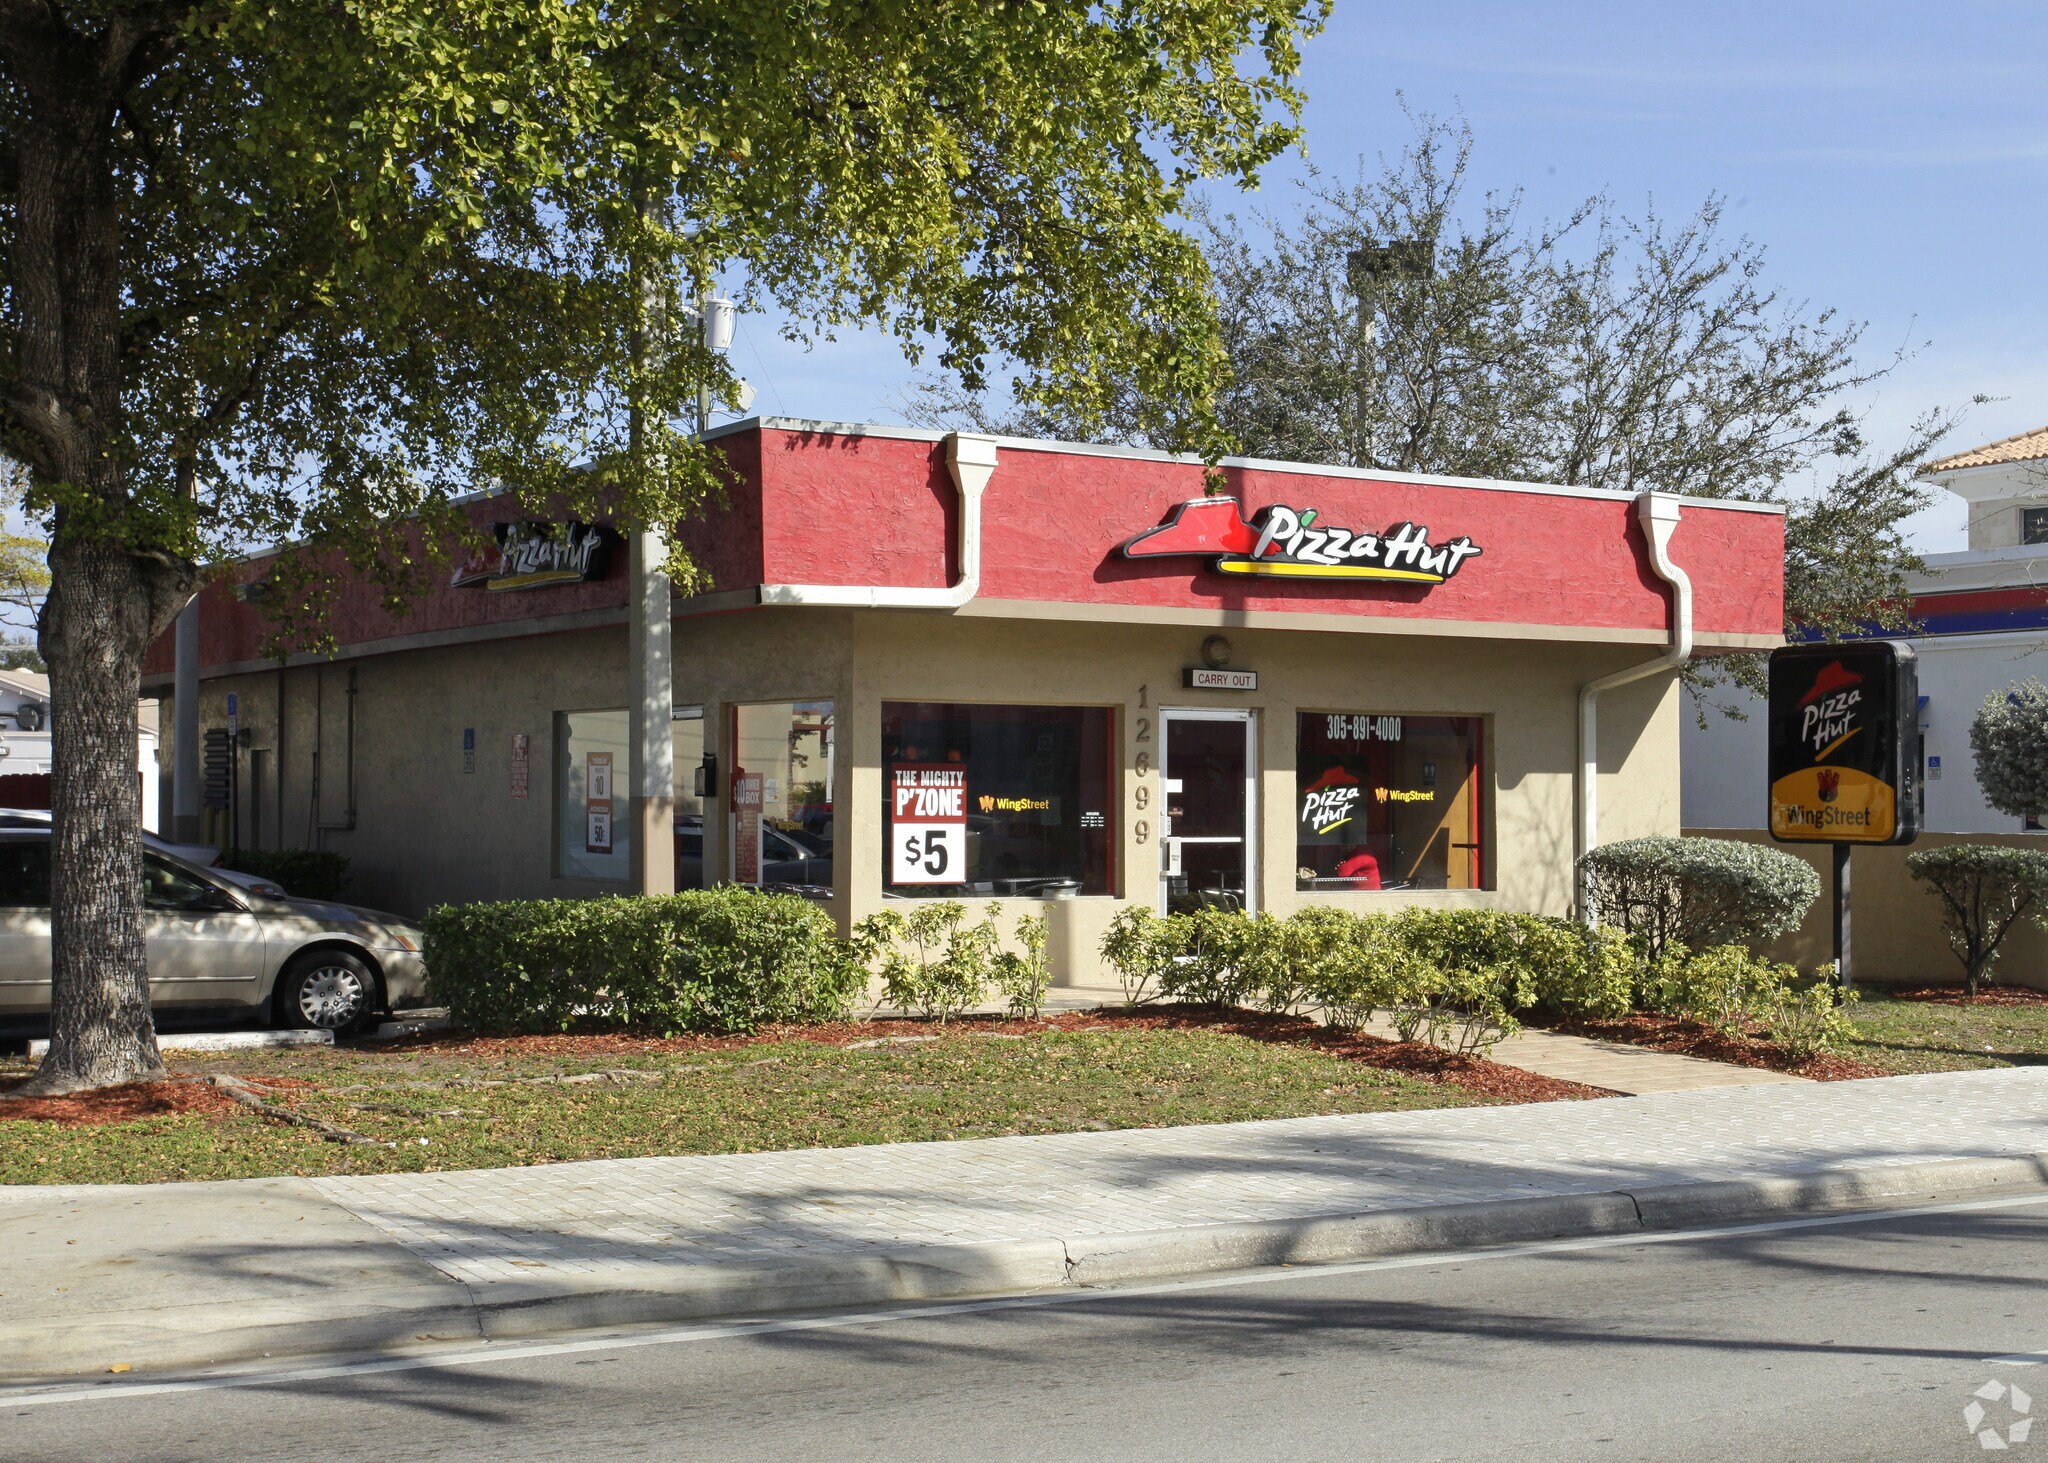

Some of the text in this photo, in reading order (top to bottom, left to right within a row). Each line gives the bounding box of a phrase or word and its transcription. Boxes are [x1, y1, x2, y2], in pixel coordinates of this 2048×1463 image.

[1254, 506, 1482, 575] Pizza Hut
[1198, 673, 1252, 686] CARRY OUT
[1327, 714, 1401, 742] 305-891-4000
[1802, 689, 1862, 743] Pizza
[1812, 712, 1857, 751] Hut
[895, 770, 964, 787] THE MIGHTY
[745, 791, 760, 804] BOX
[896, 788, 964, 817] P'ZONE
[996, 798, 1050, 812] WingStreet
[1302, 785, 1360, 823] Pizza
[1389, 789, 1435, 803] WingStreet
[1312, 803, 1354, 830] Hut
[1786, 805, 1871, 829] WingStreet
[905, 830, 949, 876] $5
